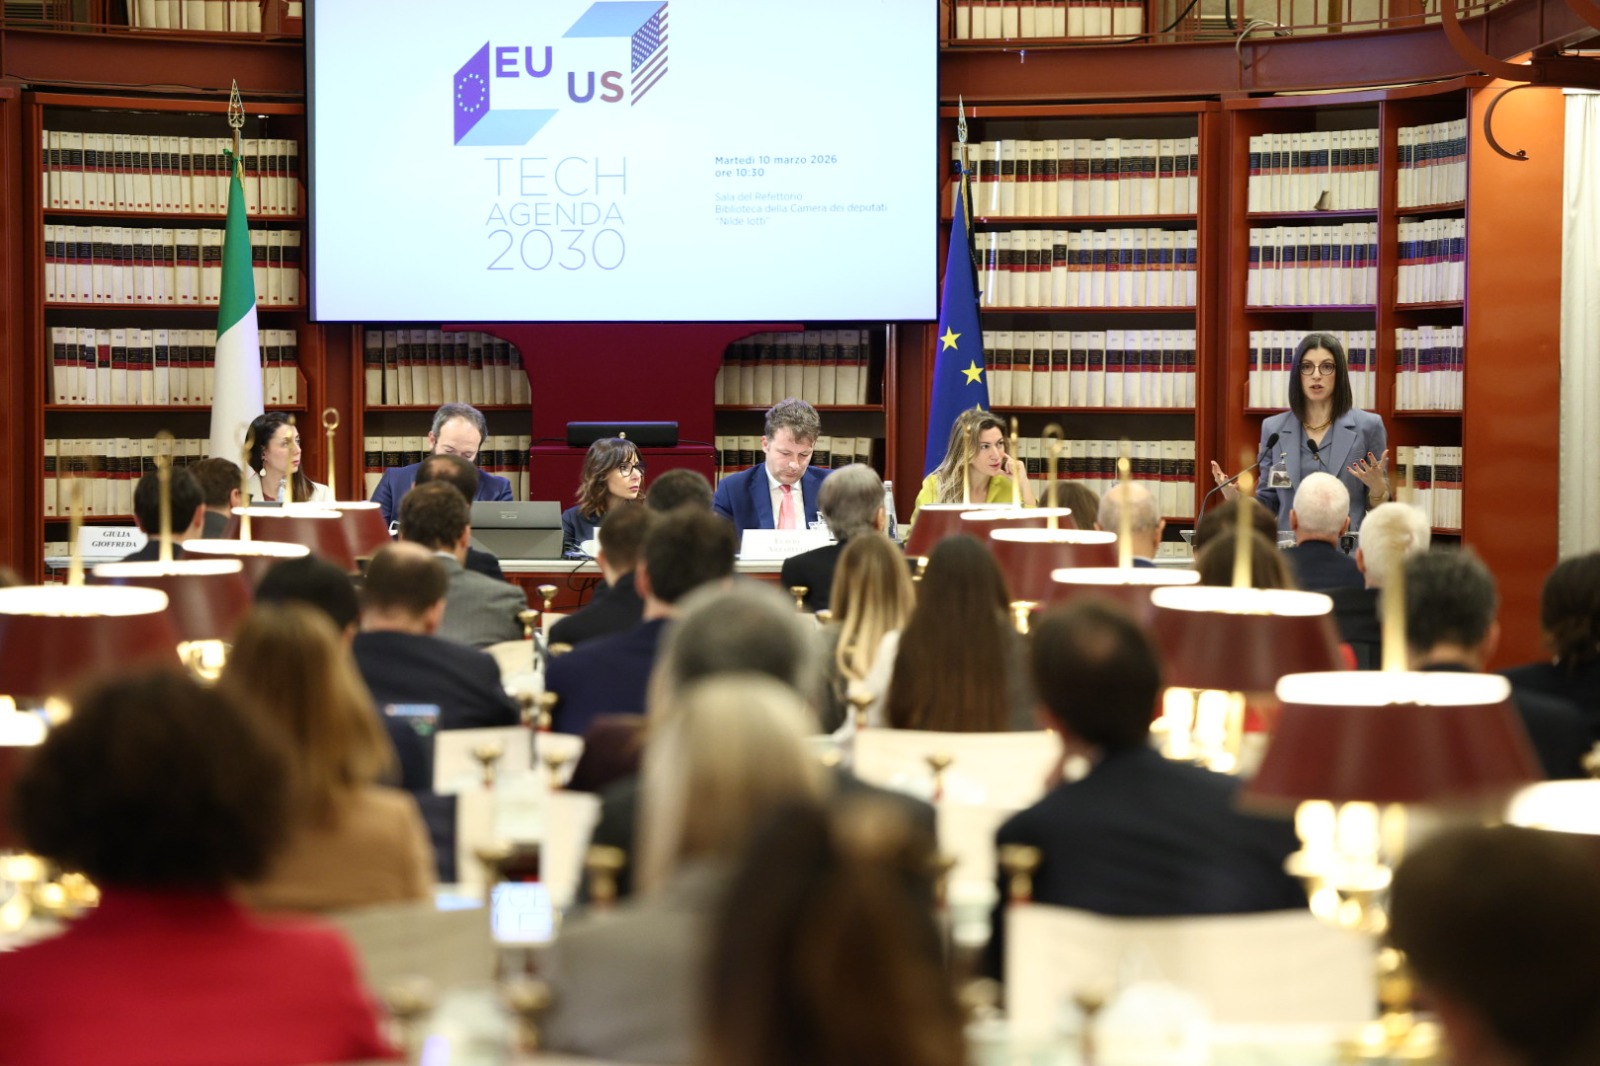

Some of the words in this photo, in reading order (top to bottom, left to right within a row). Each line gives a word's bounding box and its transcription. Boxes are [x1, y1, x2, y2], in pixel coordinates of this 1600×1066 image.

[495, 46, 553, 78] EU
[567, 71, 625, 103] US
[714, 169, 733, 178] ore
[735, 167, 765, 177] 10:30
[759, 155, 771, 165] 10
[773, 157, 807, 165] marzo
[810, 154, 838, 164] 2026
[484, 156, 627, 197] TECH
[714, 192, 736, 202] Sala
[737, 192, 753, 201] del
[754, 191, 803, 201] Refettorio
[714, 204, 763, 214] Biblioteca
[764, 204, 788, 213] della
[790, 203, 828, 213] Camera
[829, 203, 845, 212] dei
[847, 203, 888, 214] deputati
[485, 201, 625, 227] AGENDA
[486, 228, 626, 271] 2030
